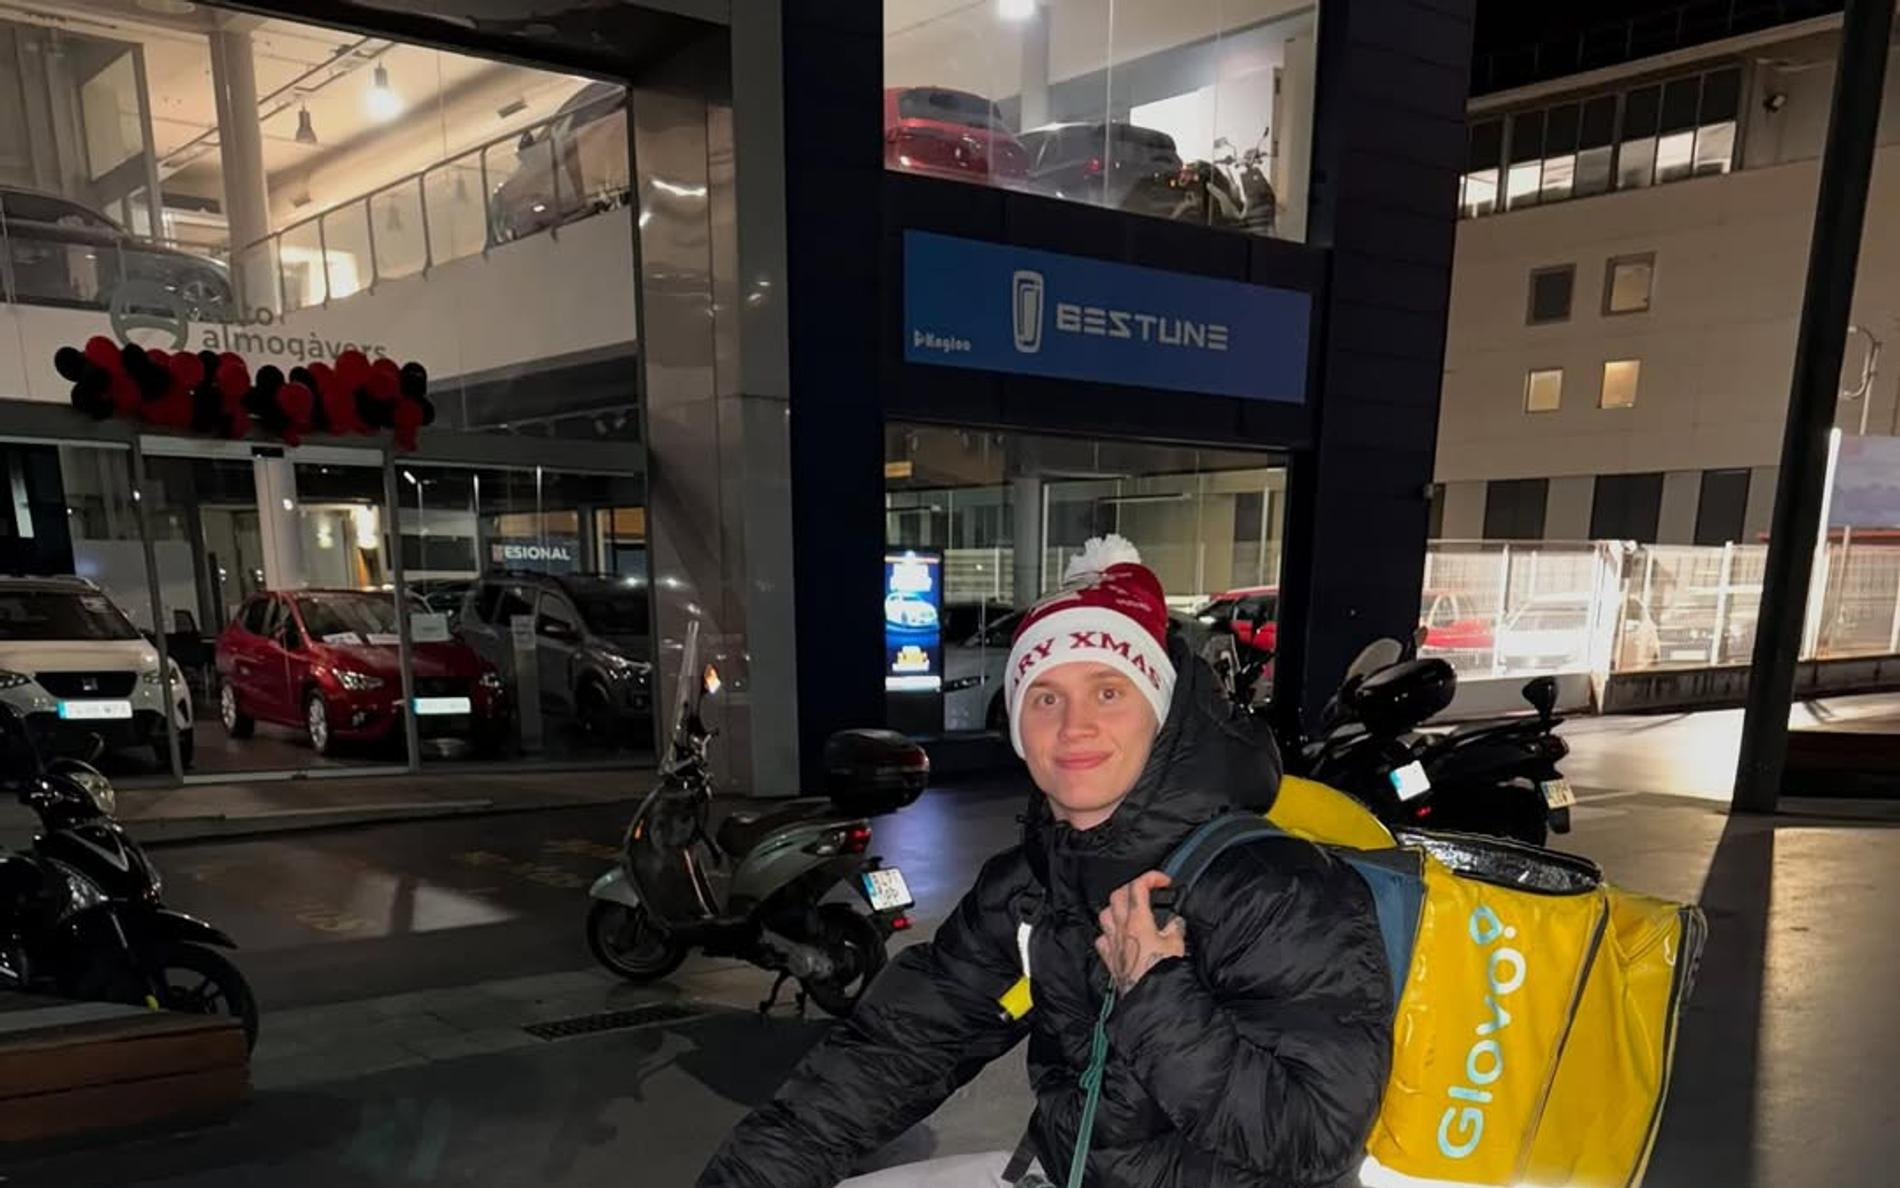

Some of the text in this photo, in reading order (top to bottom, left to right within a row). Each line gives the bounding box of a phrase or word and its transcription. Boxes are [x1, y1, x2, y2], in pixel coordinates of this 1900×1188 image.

[1055, 302, 1229, 351] BESTUNE
[1069, 630, 1163, 691] XMAS
[1436, 946, 1528, 1160] Glovo
